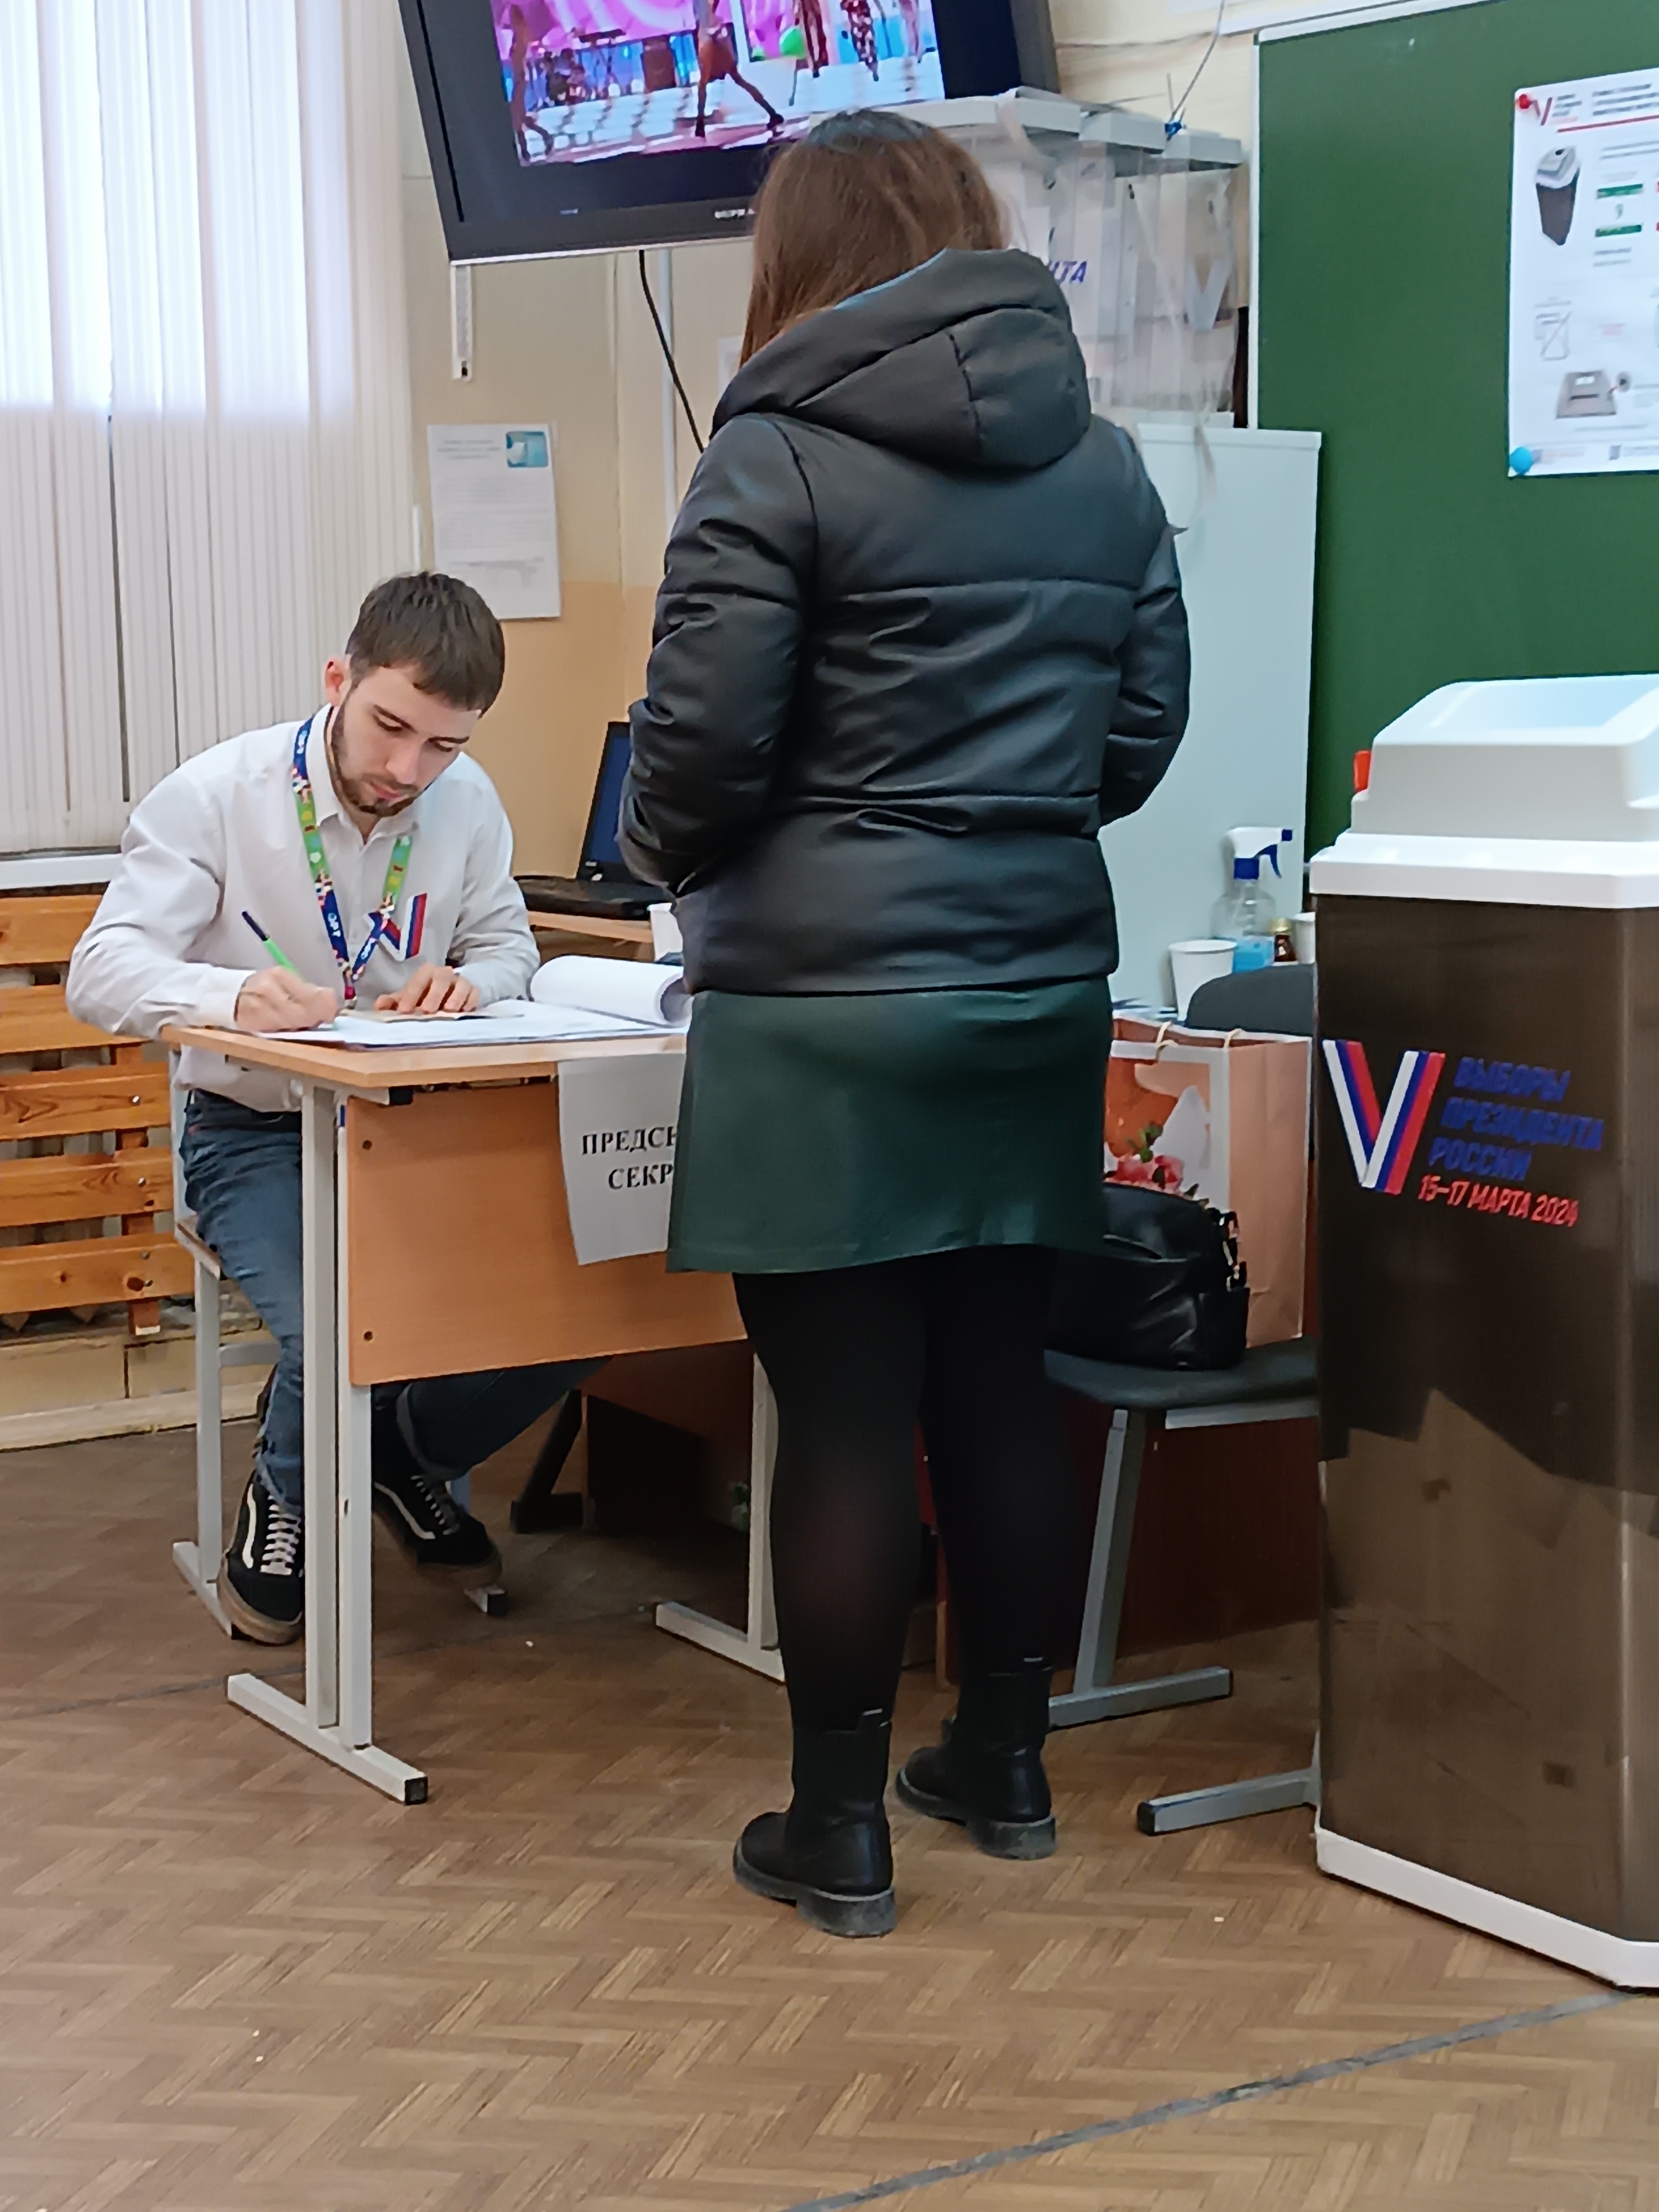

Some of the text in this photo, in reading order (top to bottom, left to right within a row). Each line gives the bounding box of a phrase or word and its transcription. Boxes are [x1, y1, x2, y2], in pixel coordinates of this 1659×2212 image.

[1454, 1056, 1571, 1102] ВЫБОРЫ
[1441, 1097, 1604, 1151] ПРЕЗИДЕНТА
[1428, 1137, 1532, 1181] РОССИИ
[1467, 1183, 1532, 1219] МАРТА
[1531, 1194, 1579, 1227] 2024
